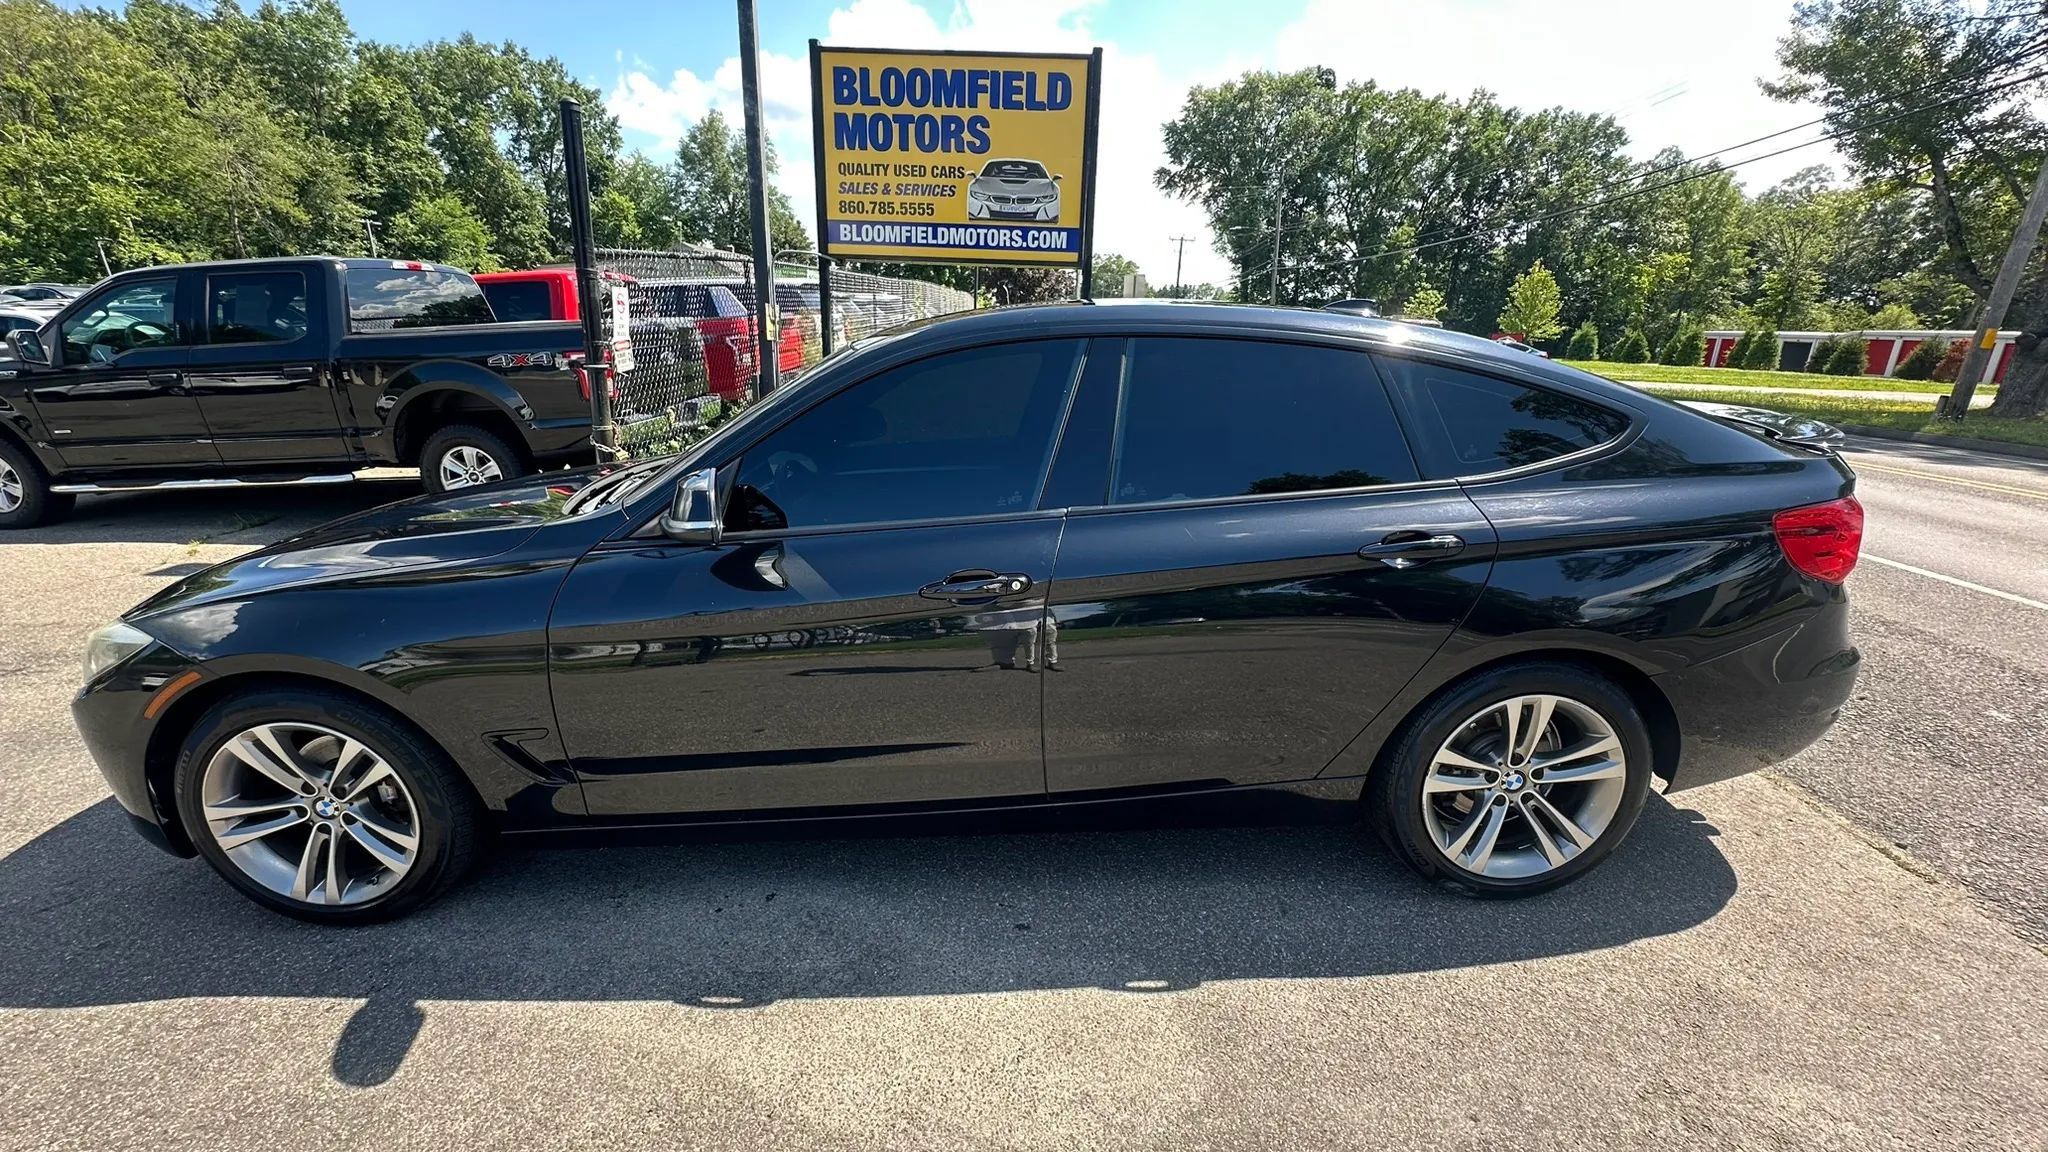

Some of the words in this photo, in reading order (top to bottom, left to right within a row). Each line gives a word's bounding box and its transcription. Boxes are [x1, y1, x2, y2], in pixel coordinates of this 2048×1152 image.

[833, 66, 1072, 111] BLOOMFIELD
[834, 112, 991, 154] MOTORS
[838, 162, 889, 177] QUALITY
[894, 164, 926, 178] USED
[931, 165, 965, 179] CARS
[838, 182, 878, 195] SALES
[881, 183, 891, 195] &
[894, 183, 957, 198] SERVICES
[839, 200, 934, 216] 860.785.5555
[839, 224, 1067, 249] BLOOMFIELDMOTORS.COM
